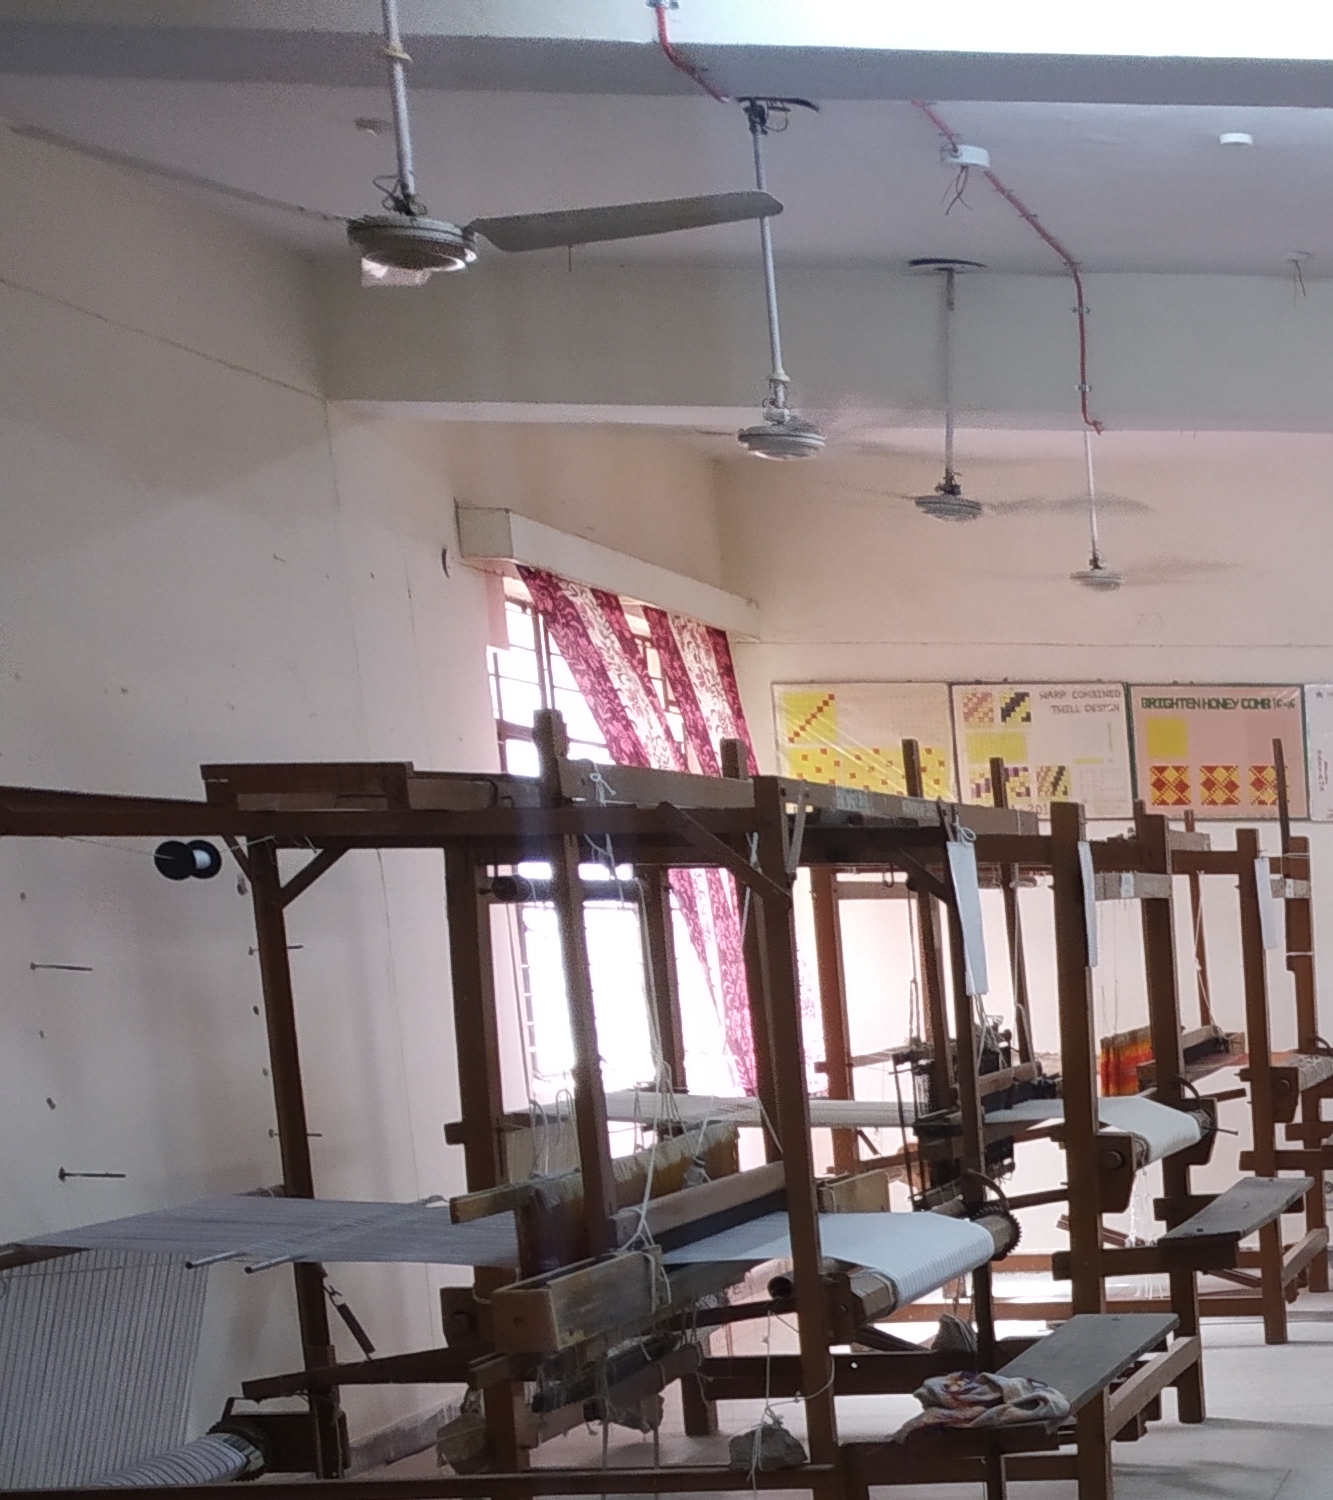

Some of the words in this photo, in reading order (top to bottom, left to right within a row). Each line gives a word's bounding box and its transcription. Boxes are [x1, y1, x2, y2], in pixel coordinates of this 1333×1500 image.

[1039, 690, 1066, 700] WARP
[1071, 690, 1121, 700] COMBINED
[1084, 704, 1120, 713] DESIGN
[1141, 697, 1201, 710] BRIGHTEN
[1202, 697, 1240, 710] HONEY
[1240, 698, 1272, 710] COMB
